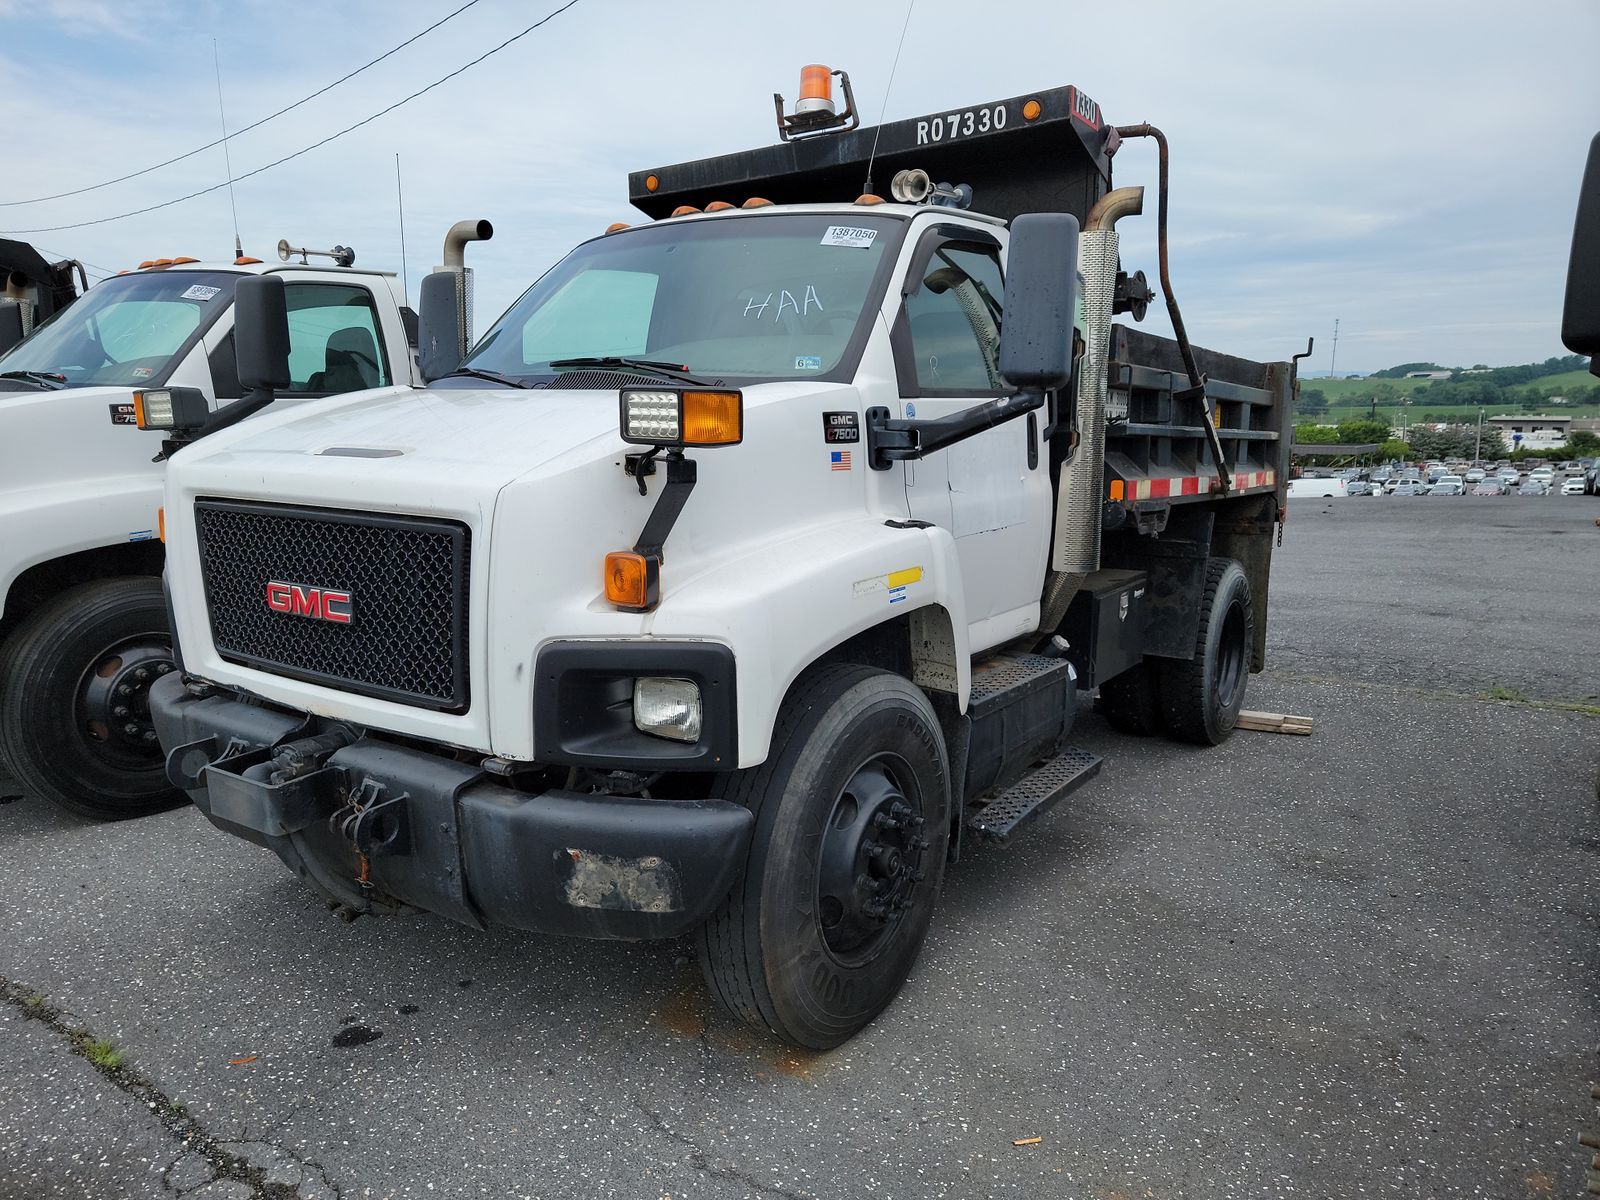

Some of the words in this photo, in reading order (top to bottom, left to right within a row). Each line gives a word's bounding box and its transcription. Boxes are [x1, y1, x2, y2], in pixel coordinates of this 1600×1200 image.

[831, 227, 876, 240] 1387050
[743, 285, 823, 322] HAA
[829, 415, 853, 425] GMC
[827, 428, 858, 440] C7500
[266, 581, 351, 624] GMC
